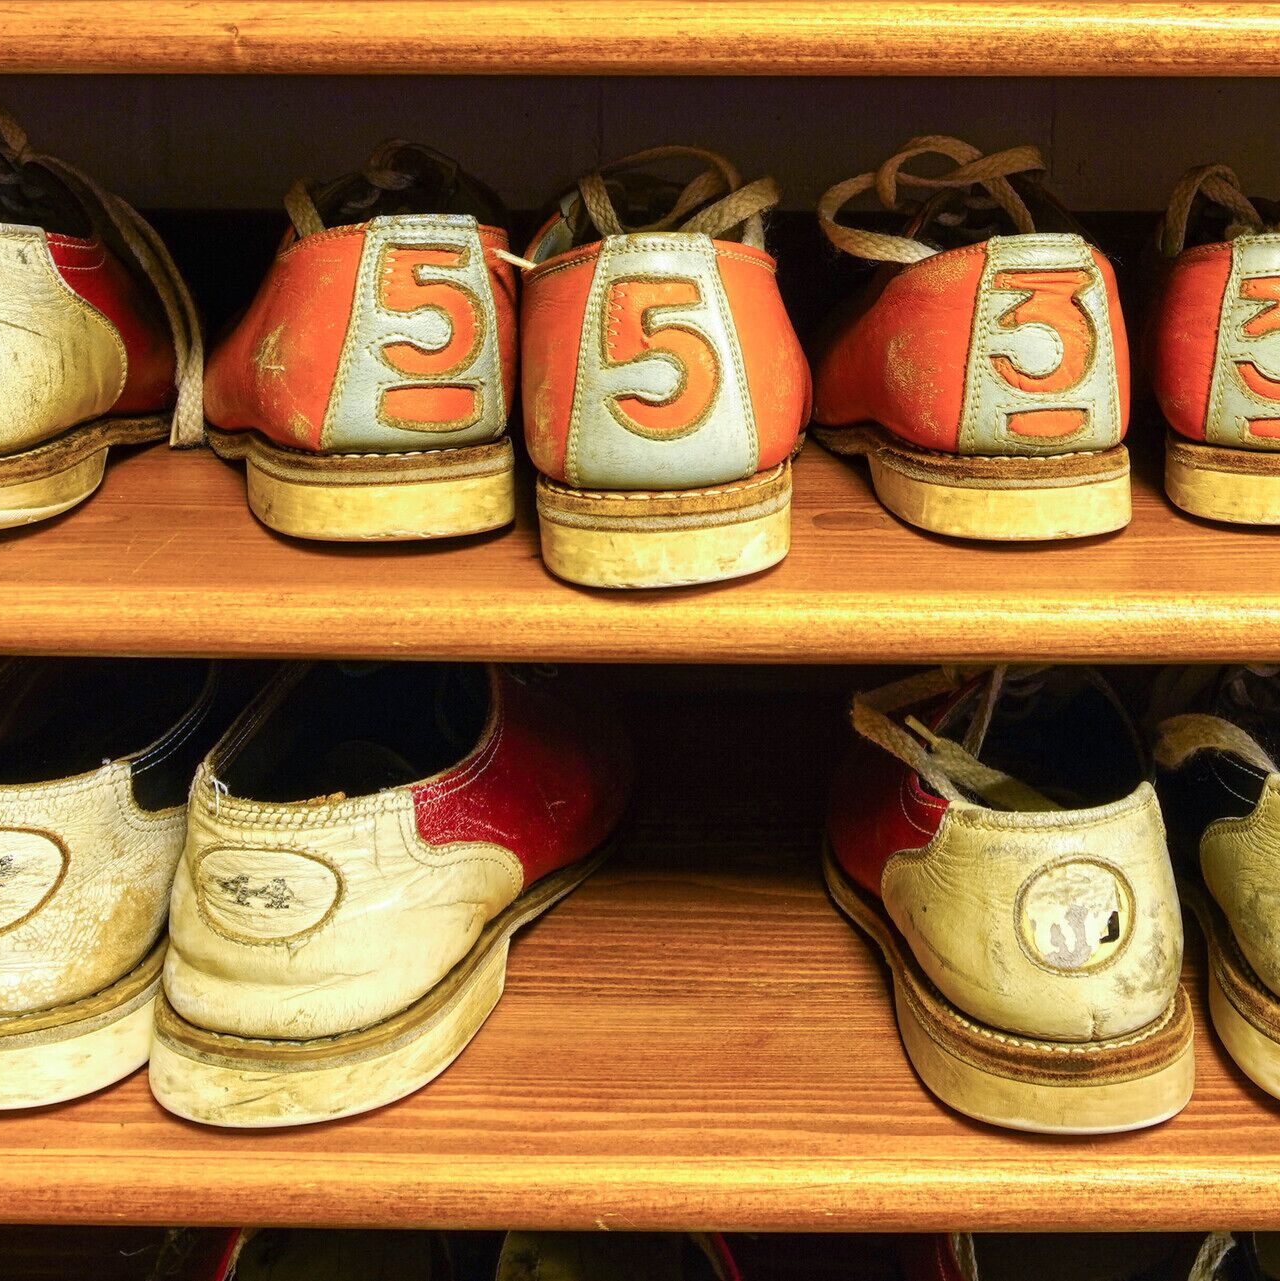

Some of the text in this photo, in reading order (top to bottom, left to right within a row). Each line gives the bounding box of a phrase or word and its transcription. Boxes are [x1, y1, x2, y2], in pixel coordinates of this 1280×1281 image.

[374, 241, 484, 376] 5
[603, 276, 719, 430] 5
[986, 267, 1098, 398] 3
